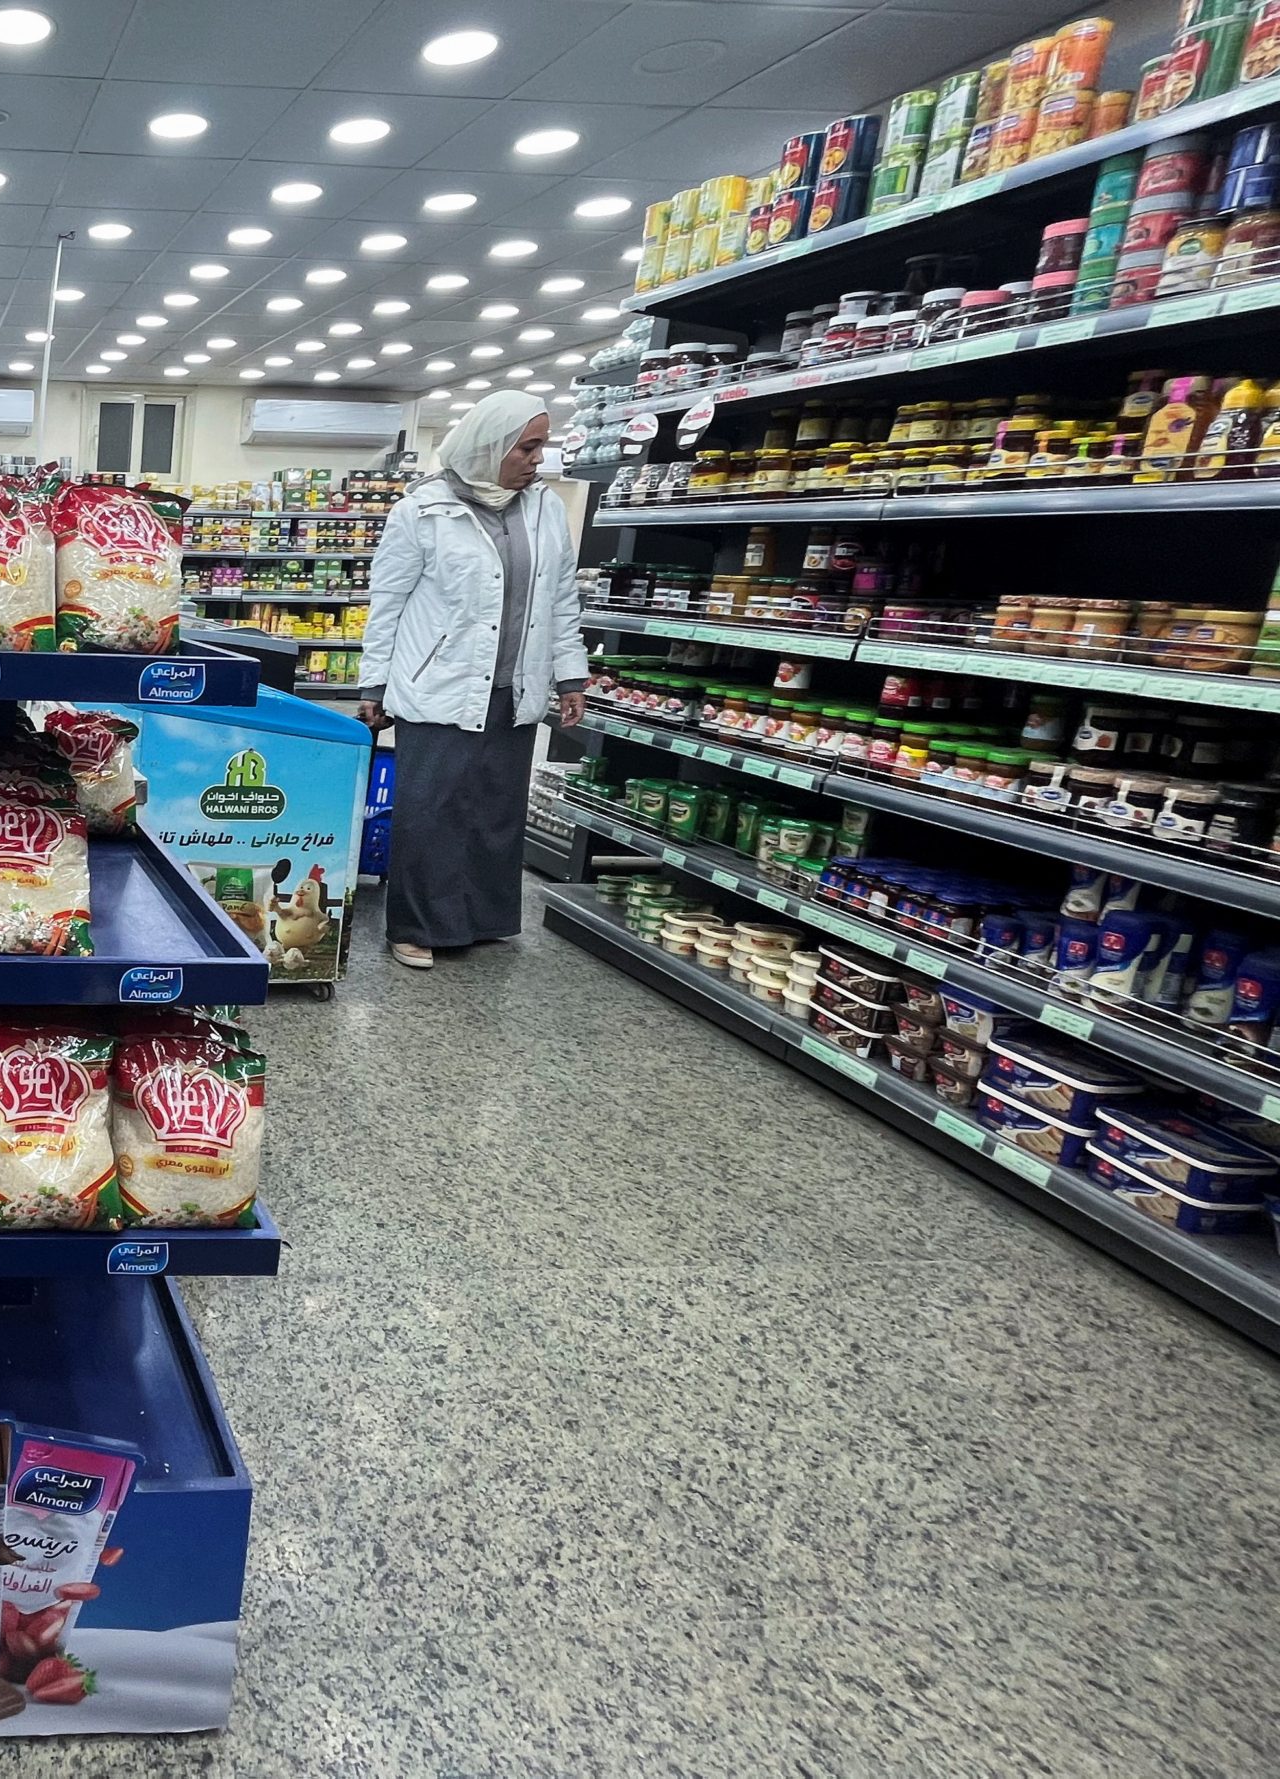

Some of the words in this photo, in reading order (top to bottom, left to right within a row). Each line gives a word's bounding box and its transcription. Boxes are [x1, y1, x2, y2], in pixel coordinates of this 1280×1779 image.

[713, 386, 749, 402] nutella
[150, 666, 196, 679] المراعي
[149, 687, 195, 699] Almarai
[206, 805, 250, 814] HALWANI
[251, 805, 279, 814] BROS
[301, 832, 335, 851] فراخ
[130, 967, 175, 984] المراعي
[129, 986, 174, 1000] Almarai
[116, 1244, 160, 1258] المراعي
[115, 1260, 158, 1273] Almarai
[34, 1471, 93, 1489] المراعي
[26, 1491, 84, 1511] Almarai
[2, 1571, 53, 1594] الفراول
